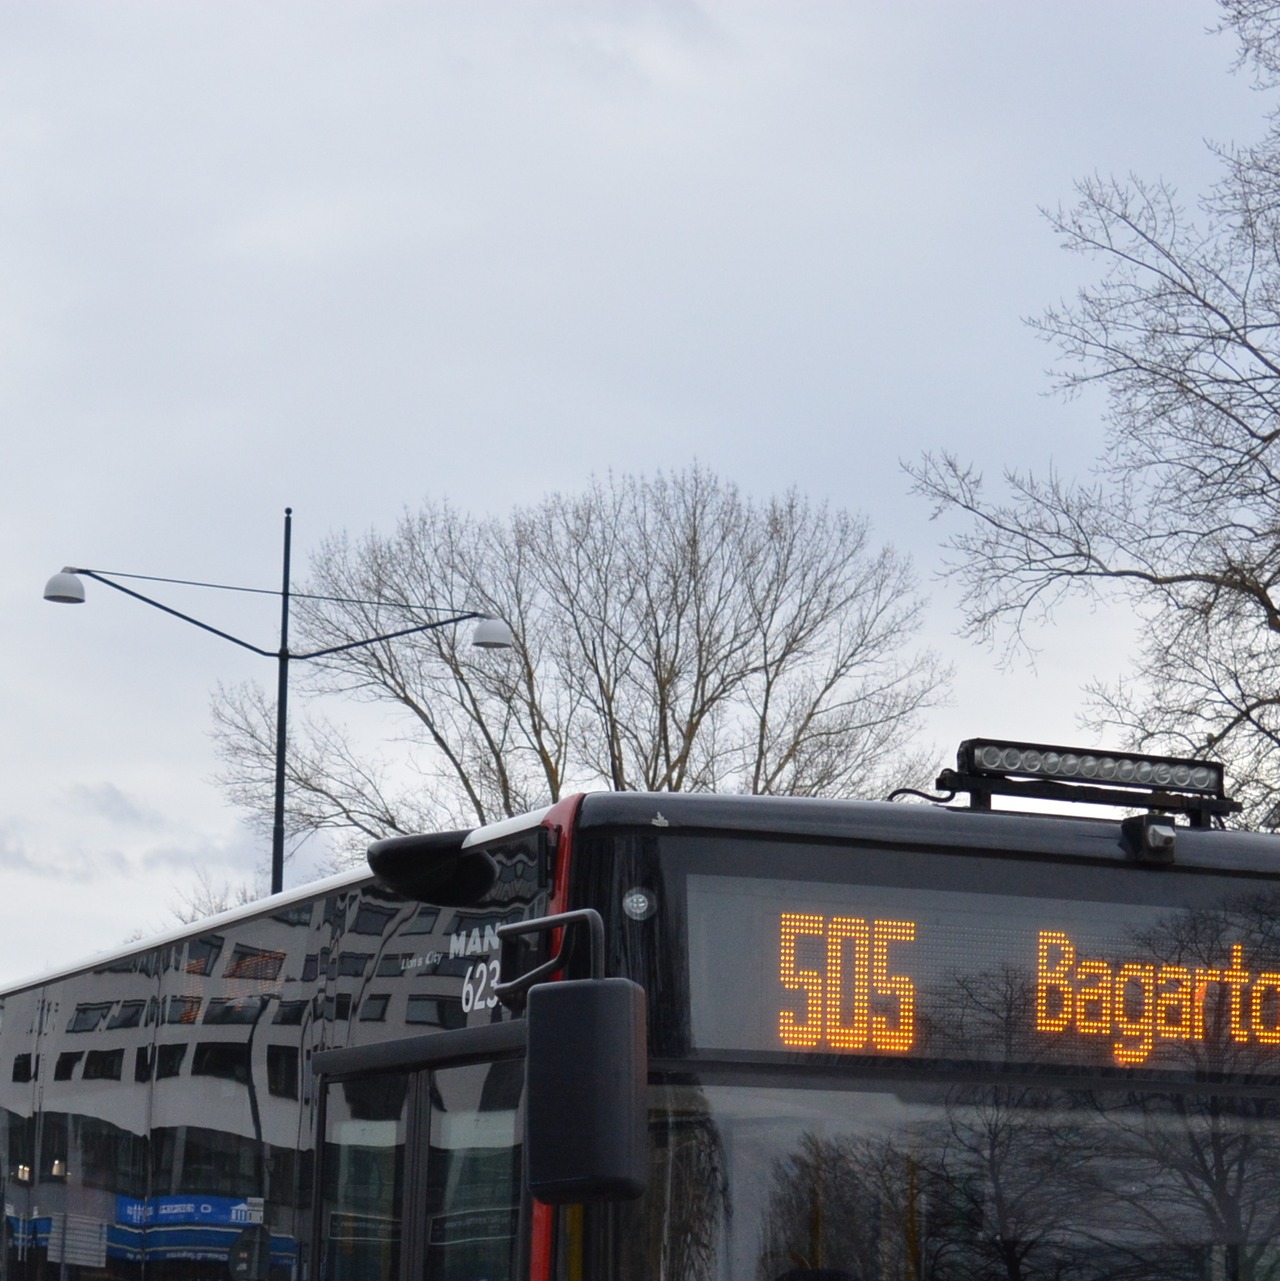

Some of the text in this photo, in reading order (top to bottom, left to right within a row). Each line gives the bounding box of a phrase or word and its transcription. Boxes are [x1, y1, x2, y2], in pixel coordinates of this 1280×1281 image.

[425, 951, 443, 965] City
[449, 921, 501, 959] MAN
[462, 960, 502, 1013] 623
[779, 912, 917, 1051] 505
